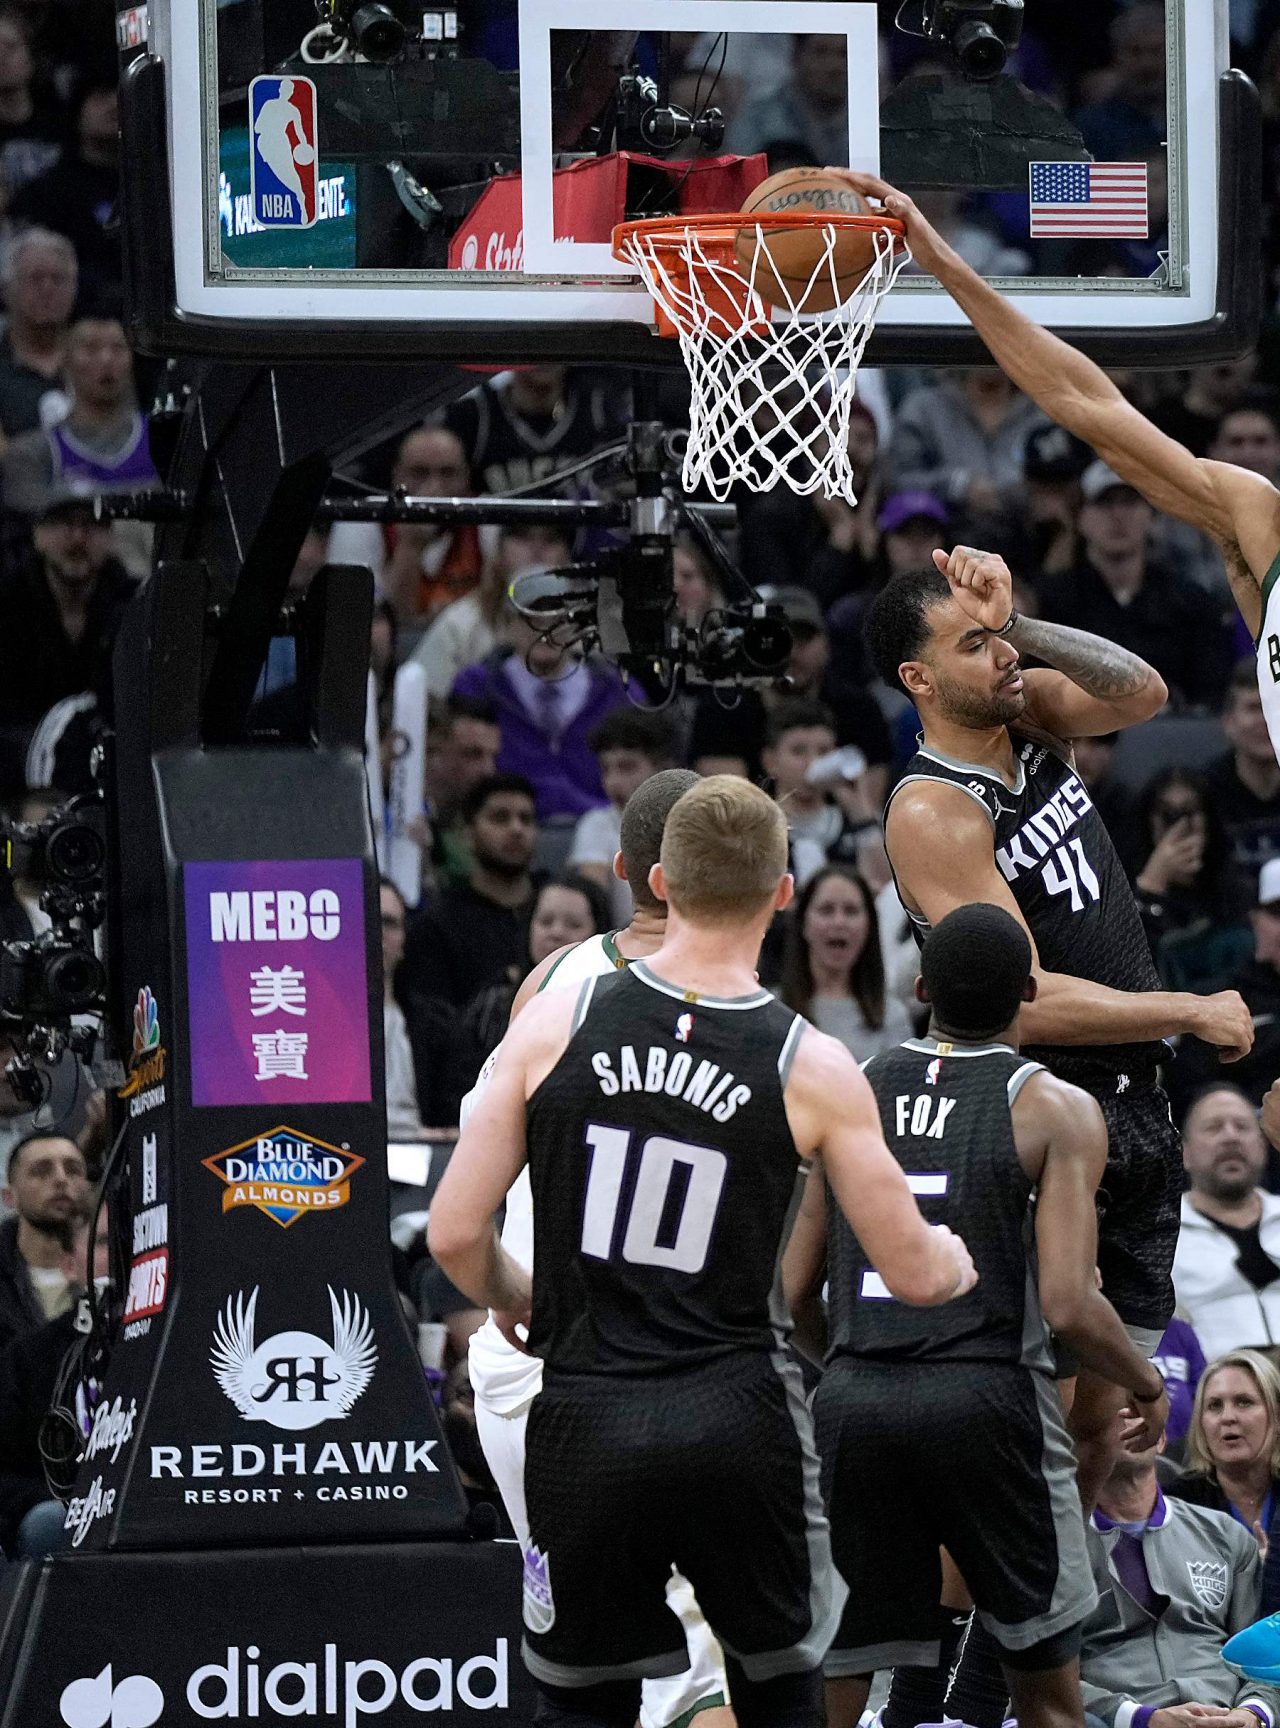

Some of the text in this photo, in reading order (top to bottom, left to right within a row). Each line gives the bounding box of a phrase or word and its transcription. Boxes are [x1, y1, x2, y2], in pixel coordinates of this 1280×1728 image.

[262, 194, 294, 219] NBA
[995, 775, 1093, 882] KINGS
[1040, 836, 1101, 913] 41
[209, 888, 341, 943] MEBO
[249, 964, 309, 1081] 美寶
[591, 1045, 752, 1123] SABONIS
[895, 1094, 957, 1139] FOX
[226, 1156, 345, 1182] DIAMOND
[257, 1138, 315, 1163] BLUE
[233, 1187, 342, 1206] ALMONDS
[580, 1123, 728, 1275] 10
[150, 1439, 441, 1478] REDHAWK
[184, 1488, 282, 1504] RESORT
[316, 1485, 408, 1502] CASINO
[186, 1637, 509, 1728] dialpad
